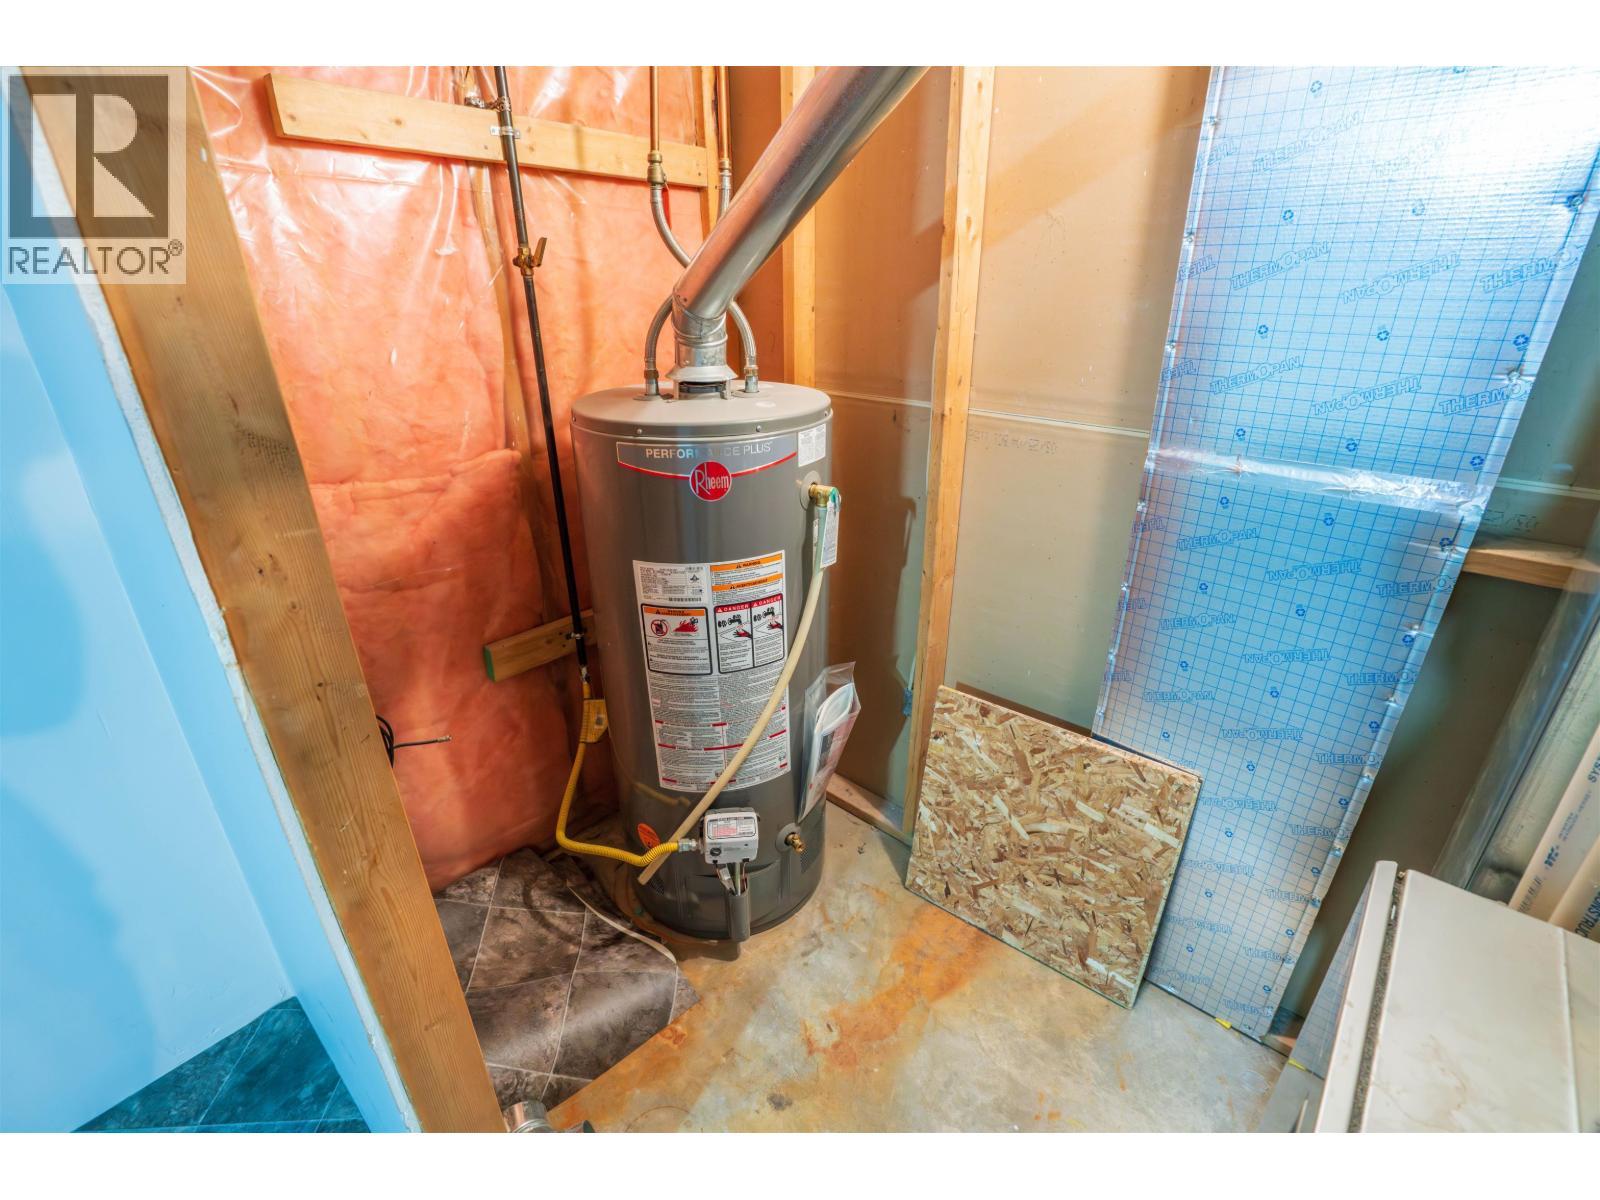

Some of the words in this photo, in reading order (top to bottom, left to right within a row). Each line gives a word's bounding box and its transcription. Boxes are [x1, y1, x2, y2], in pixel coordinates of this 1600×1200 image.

[1231, 240, 1332, 291] THERMOPAN
[1342, 251, 1460, 304] THERMOPAN
[1209, 356, 1301, 395] THERMOPAN
[1313, 375, 1423, 416] THERMOPAN
[693, 463, 729, 496] Rheem
[1176, 527, 1260, 551] THERMOPAN
[1265, 559, 1362, 582] THERMOPAN
[723, 603, 749, 612] DANGER
[1159, 612, 1236, 630] THERMOPAN
[1242, 649, 1333, 666] THERMOPAN
[1220, 728, 1303, 742] THERMOPAN
